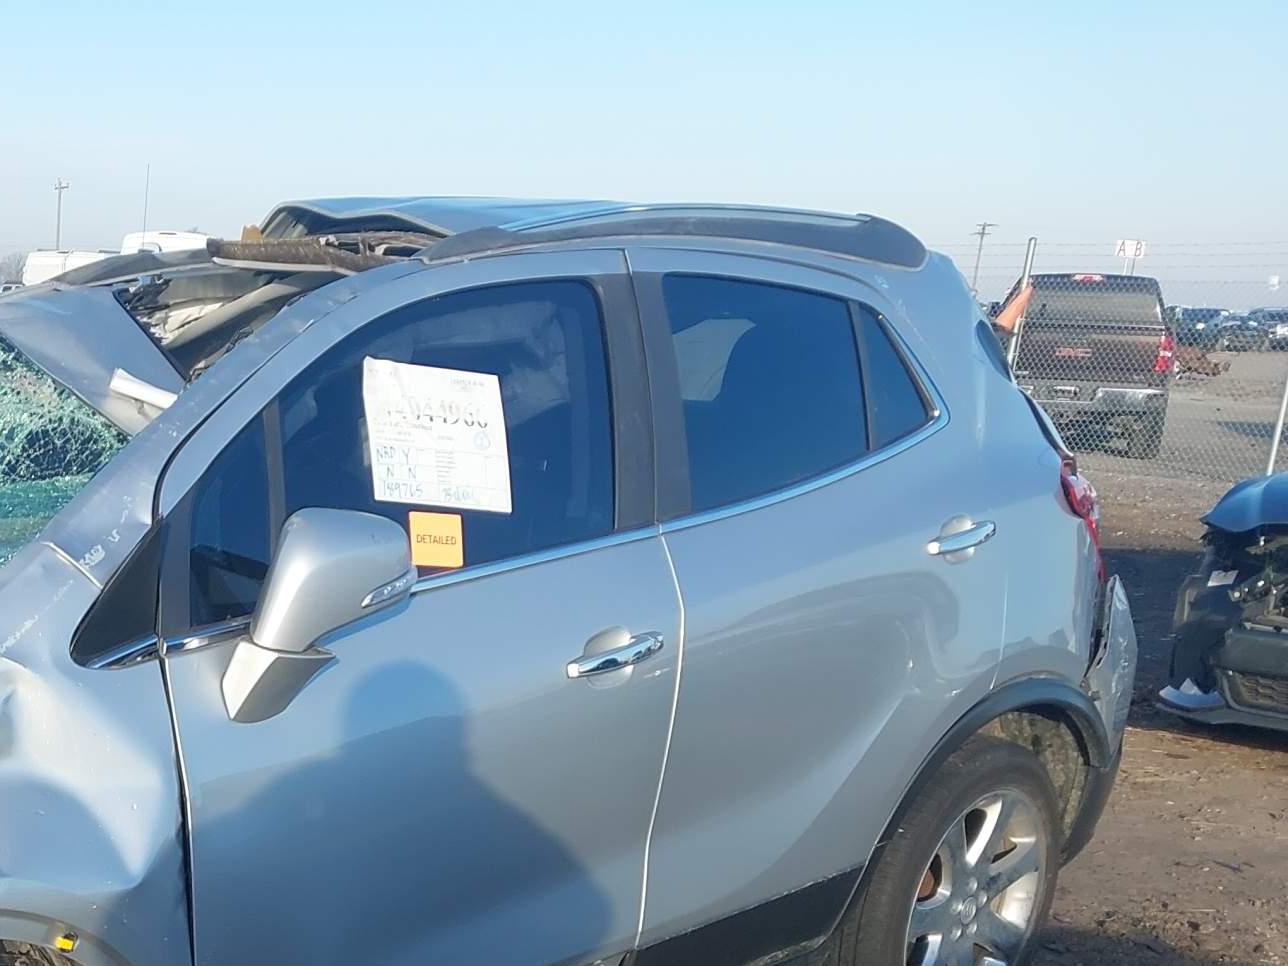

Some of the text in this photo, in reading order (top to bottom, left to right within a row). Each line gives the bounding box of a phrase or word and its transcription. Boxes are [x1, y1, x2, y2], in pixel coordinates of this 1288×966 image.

[1117, 240, 1143, 257] A B
[401, 447, 410, 465] Y
[386, 464, 417, 479] N N
[416, 534, 457, 546] DETAILED
